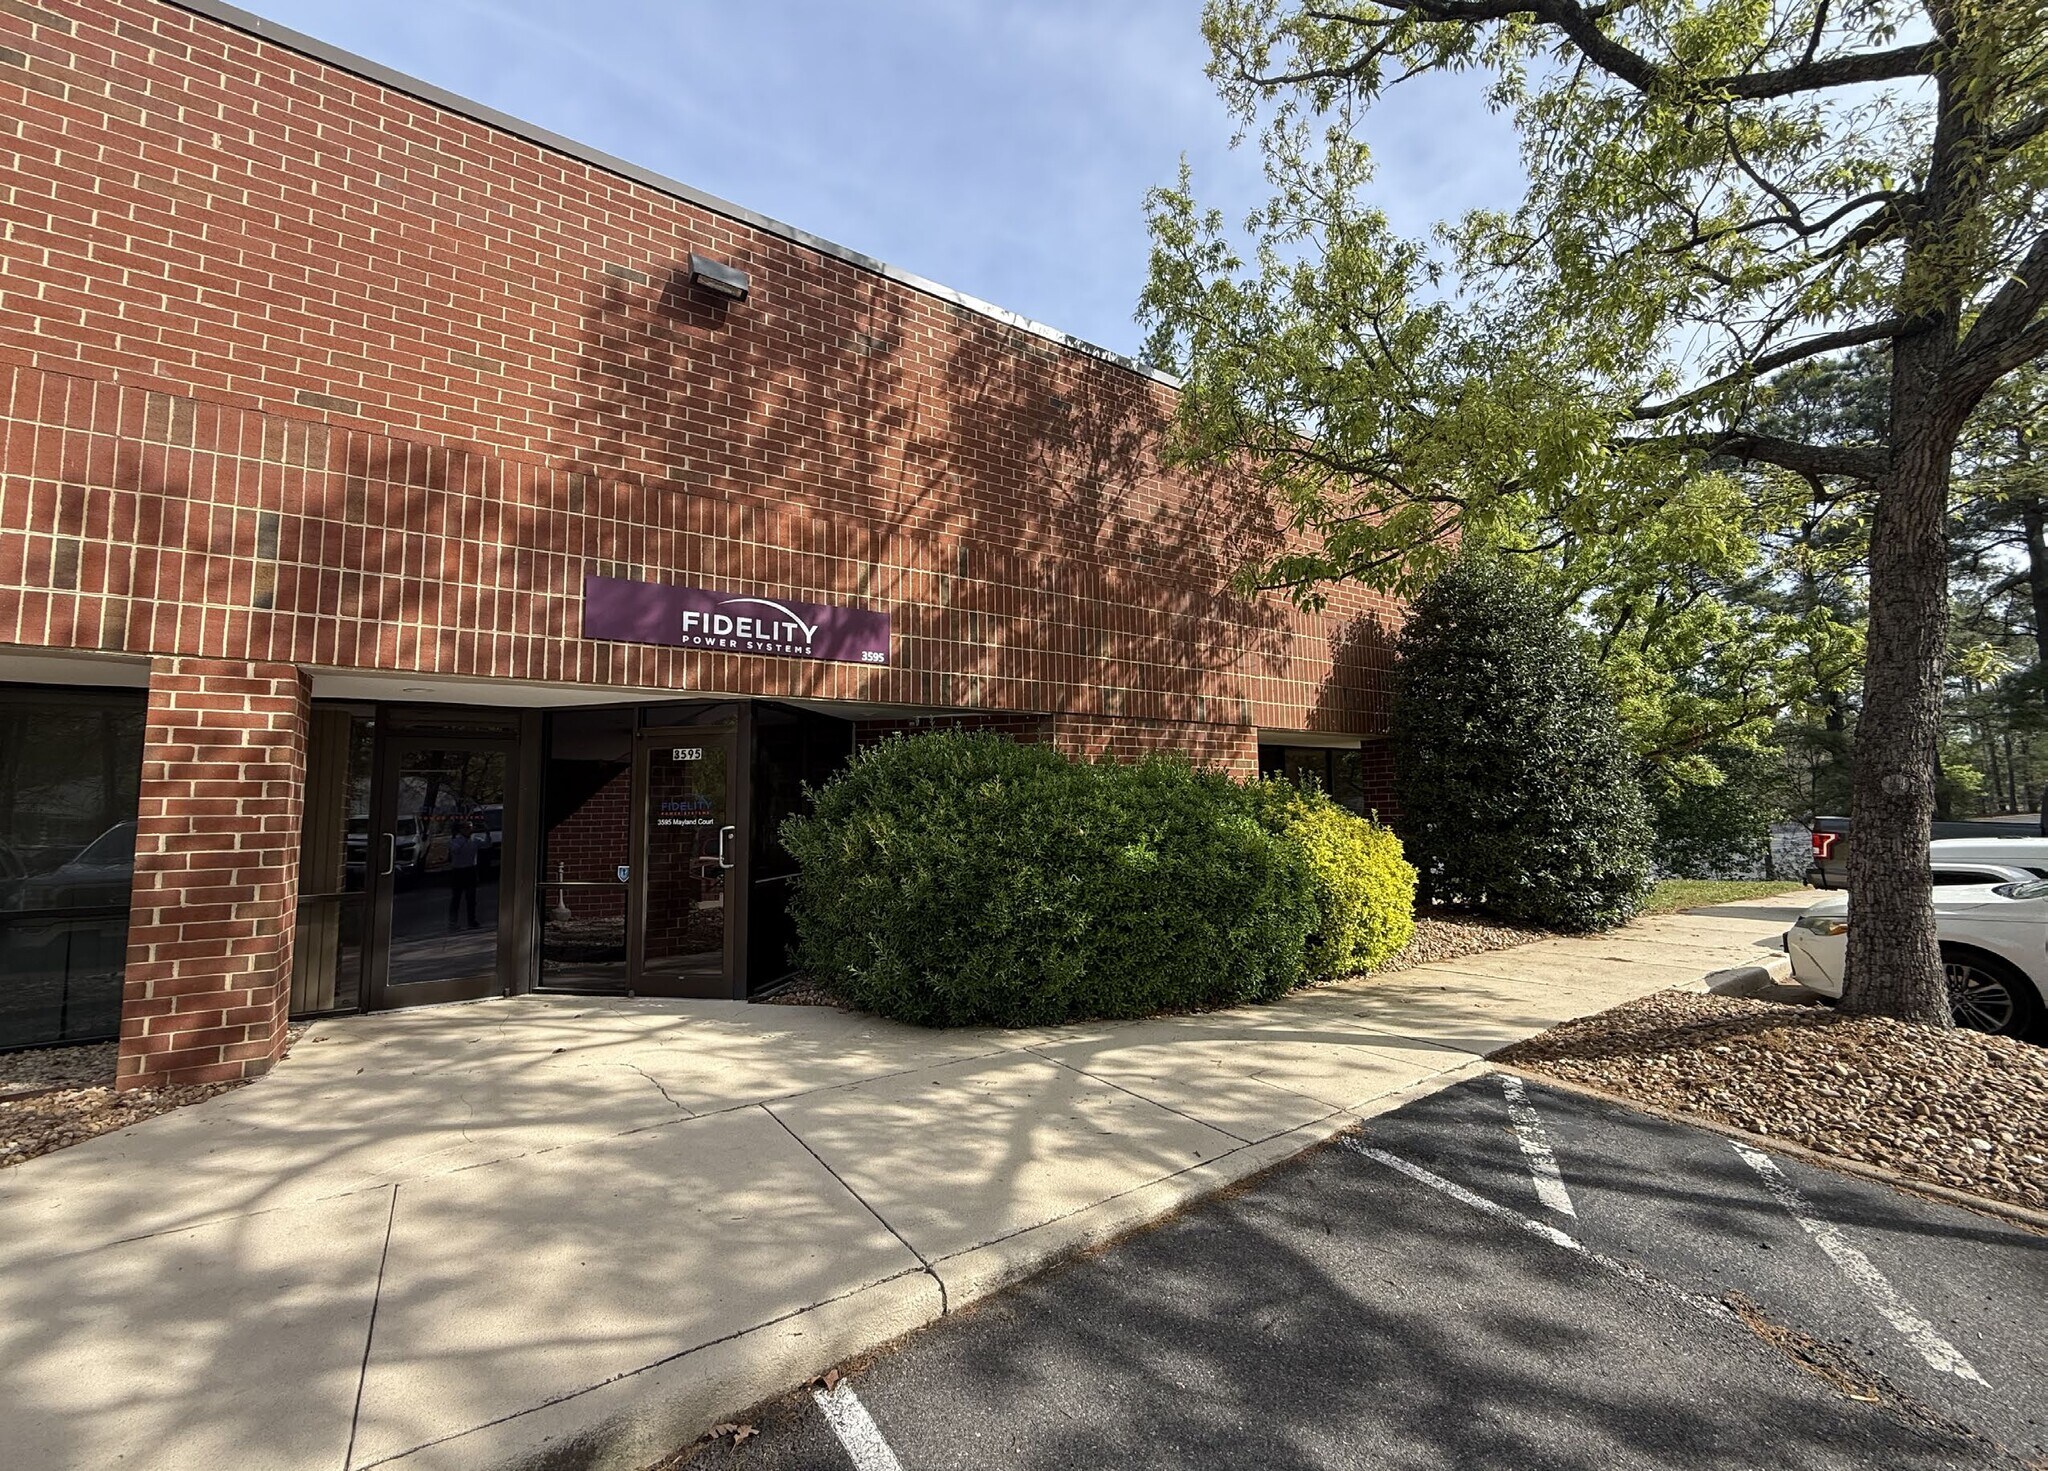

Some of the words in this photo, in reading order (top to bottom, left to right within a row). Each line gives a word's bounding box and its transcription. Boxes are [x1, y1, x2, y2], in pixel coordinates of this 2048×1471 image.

[682, 610, 818, 644] FIDELITY
[682, 635, 737, 648] POWER
[747, 641, 812, 655] SYSTEMS
[861, 651, 885, 662] 3595
[674, 749, 701, 759] 3595
[661, 801, 712, 811] FIDELITY
[673, 818, 697, 827] Mayland
